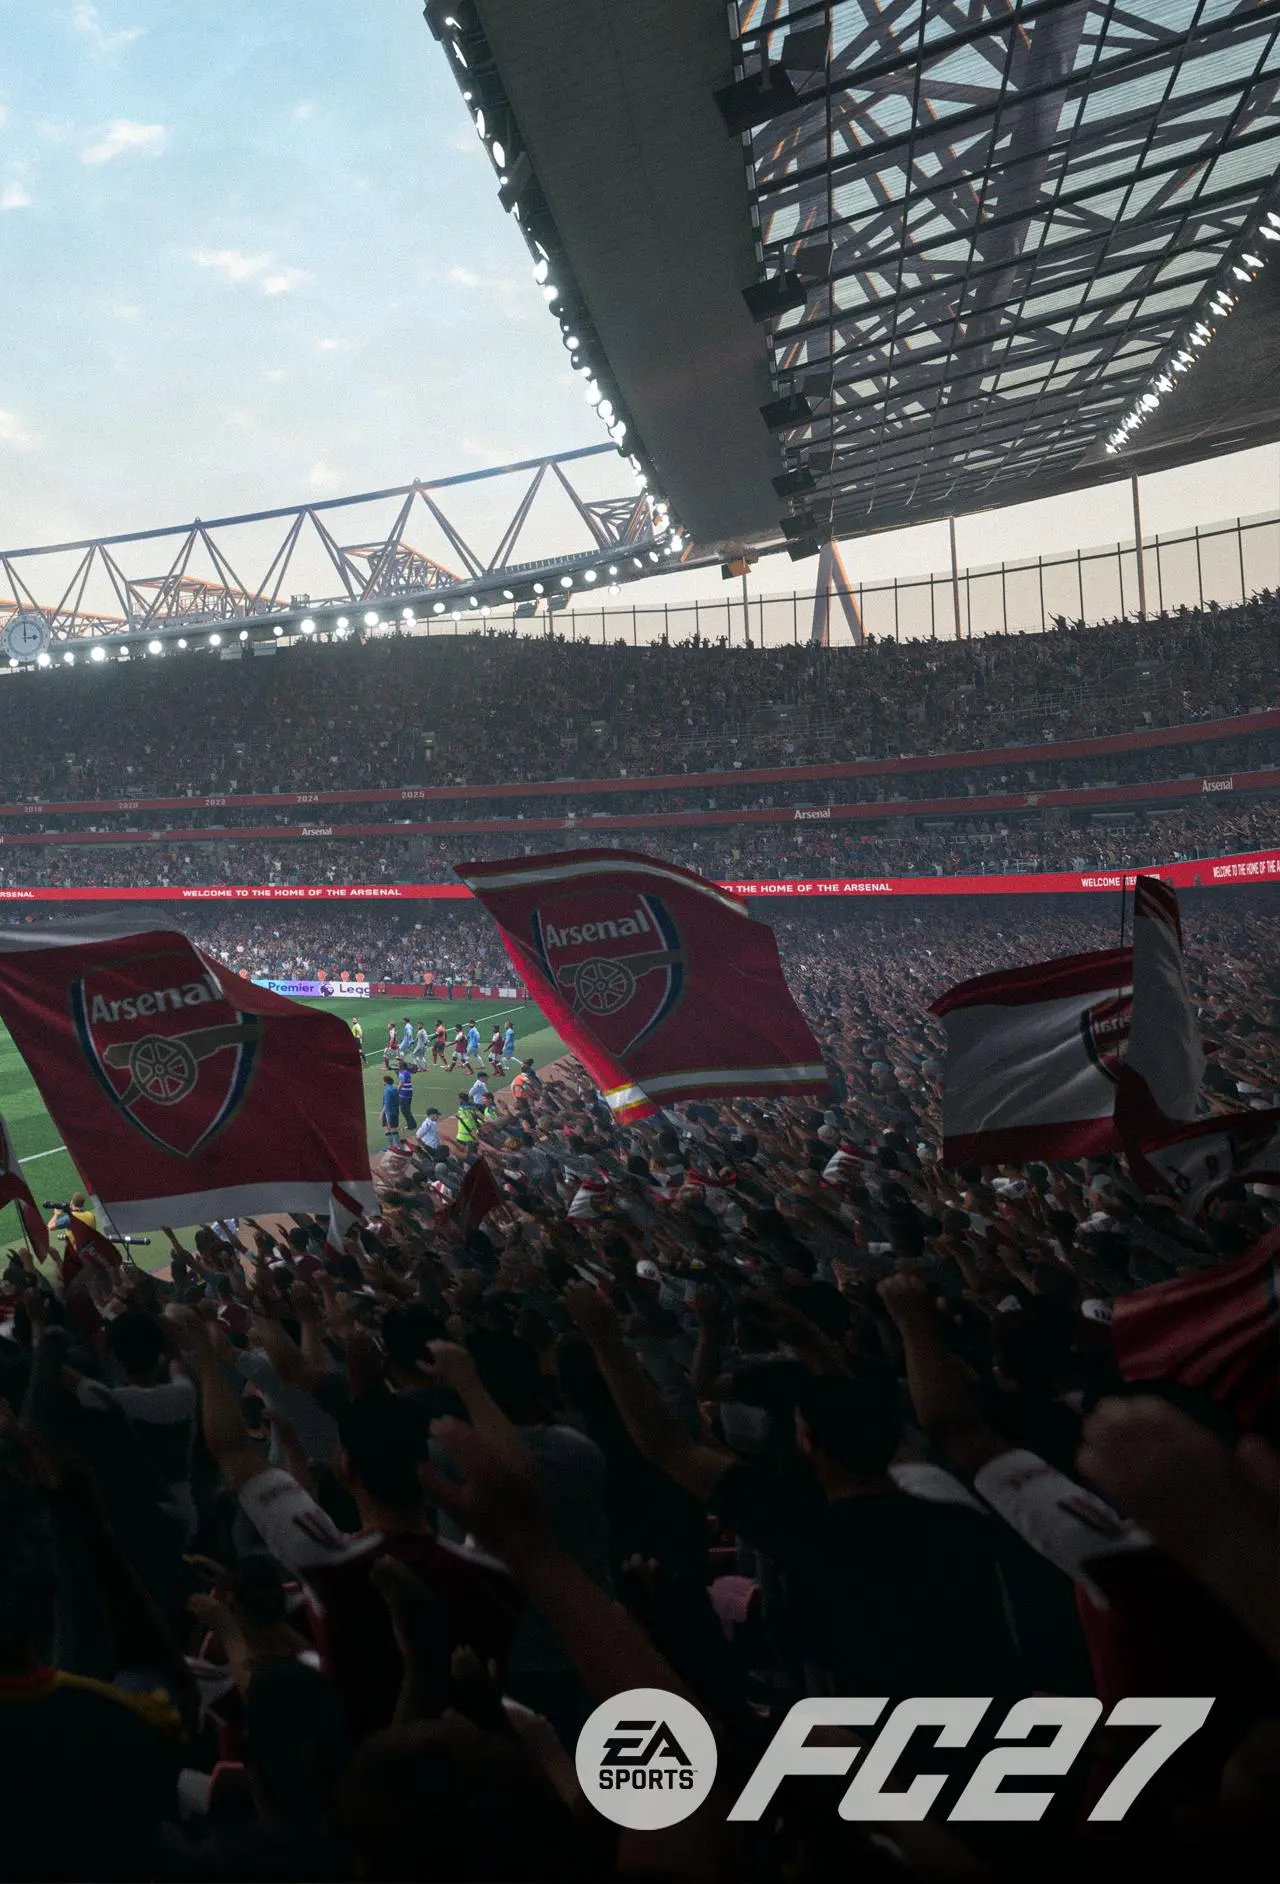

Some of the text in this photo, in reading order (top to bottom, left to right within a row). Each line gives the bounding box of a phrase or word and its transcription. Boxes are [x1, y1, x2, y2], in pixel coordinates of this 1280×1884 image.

[1202, 777, 1233, 793] Arsenal
[296, 795, 319, 803] 2024
[401, 791, 425, 800] 2025
[794, 808, 831, 820] Arsenal
[301, 827, 333, 837] Arsenal
[736, 885, 757, 893] THE
[760, 884, 793, 893] HOME
[797, 884, 813, 893] OF
[817, 884, 840, 892] THE
[843, 883, 893, 892] ARSENAL
[1081, 877, 1121, 888] WELCOME
[252, 889, 271, 897] THE
[274, 889, 305, 897] HOME
[350, 888, 402, 896] ARSENAL
[546, 908, 651, 952] Arsenal
[268, 982, 315, 993] Premier
[91, 973, 224, 1025] Arsenal
